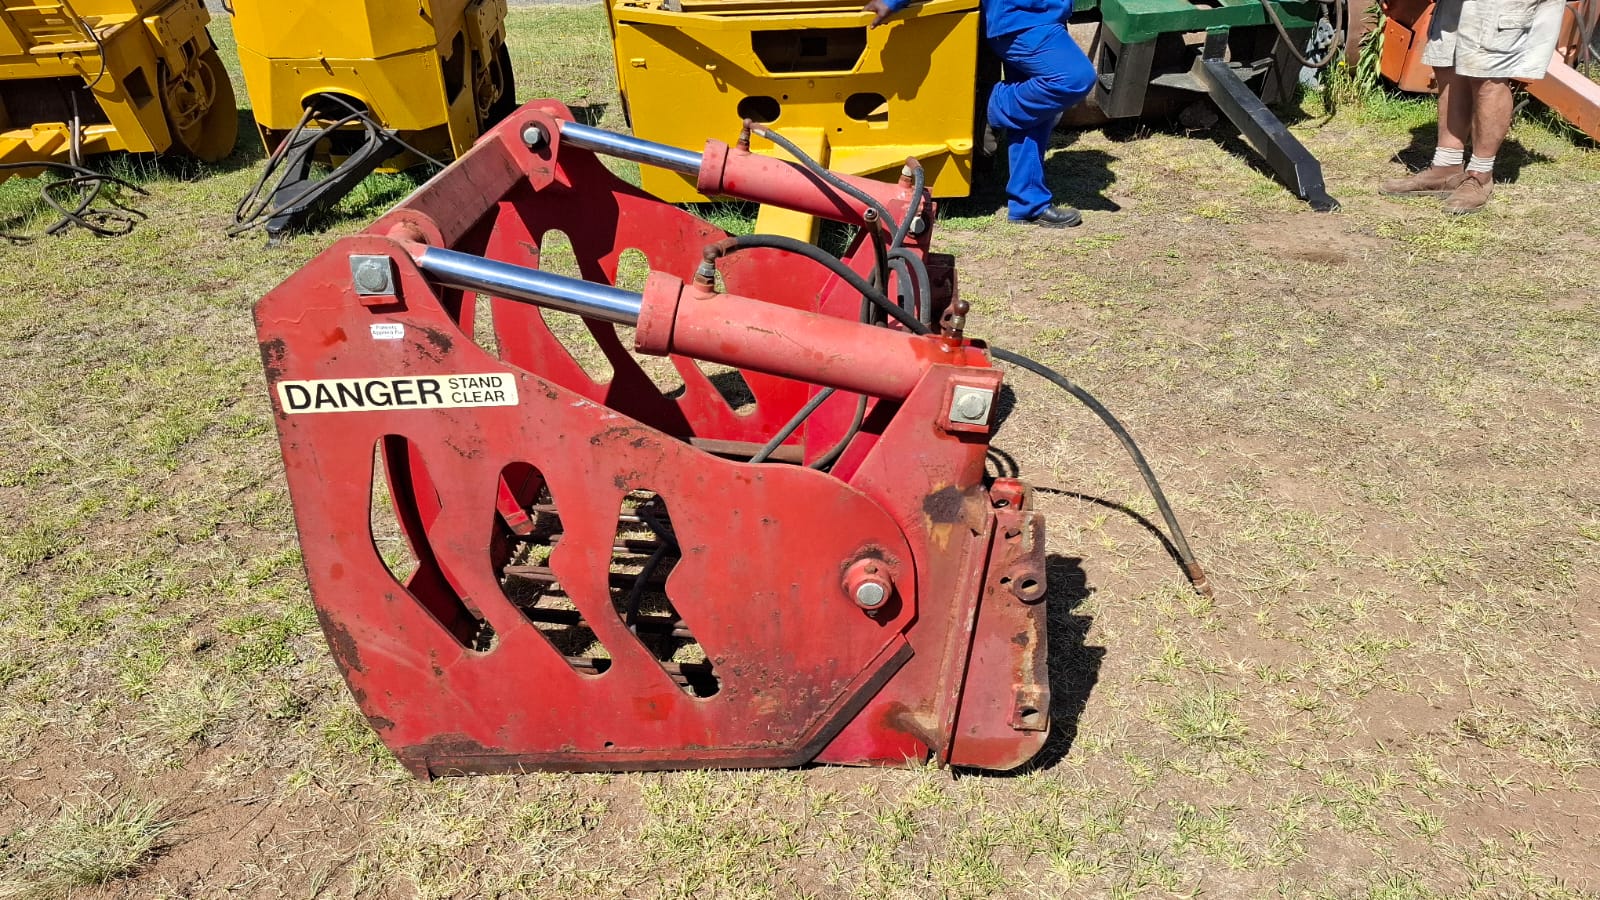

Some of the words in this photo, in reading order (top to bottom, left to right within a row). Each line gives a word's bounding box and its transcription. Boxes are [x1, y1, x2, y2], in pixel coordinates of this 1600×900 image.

[448, 376, 502, 389] STAND
[284, 379, 443, 410] DANGER
[451, 390, 505, 403] CLEAR
